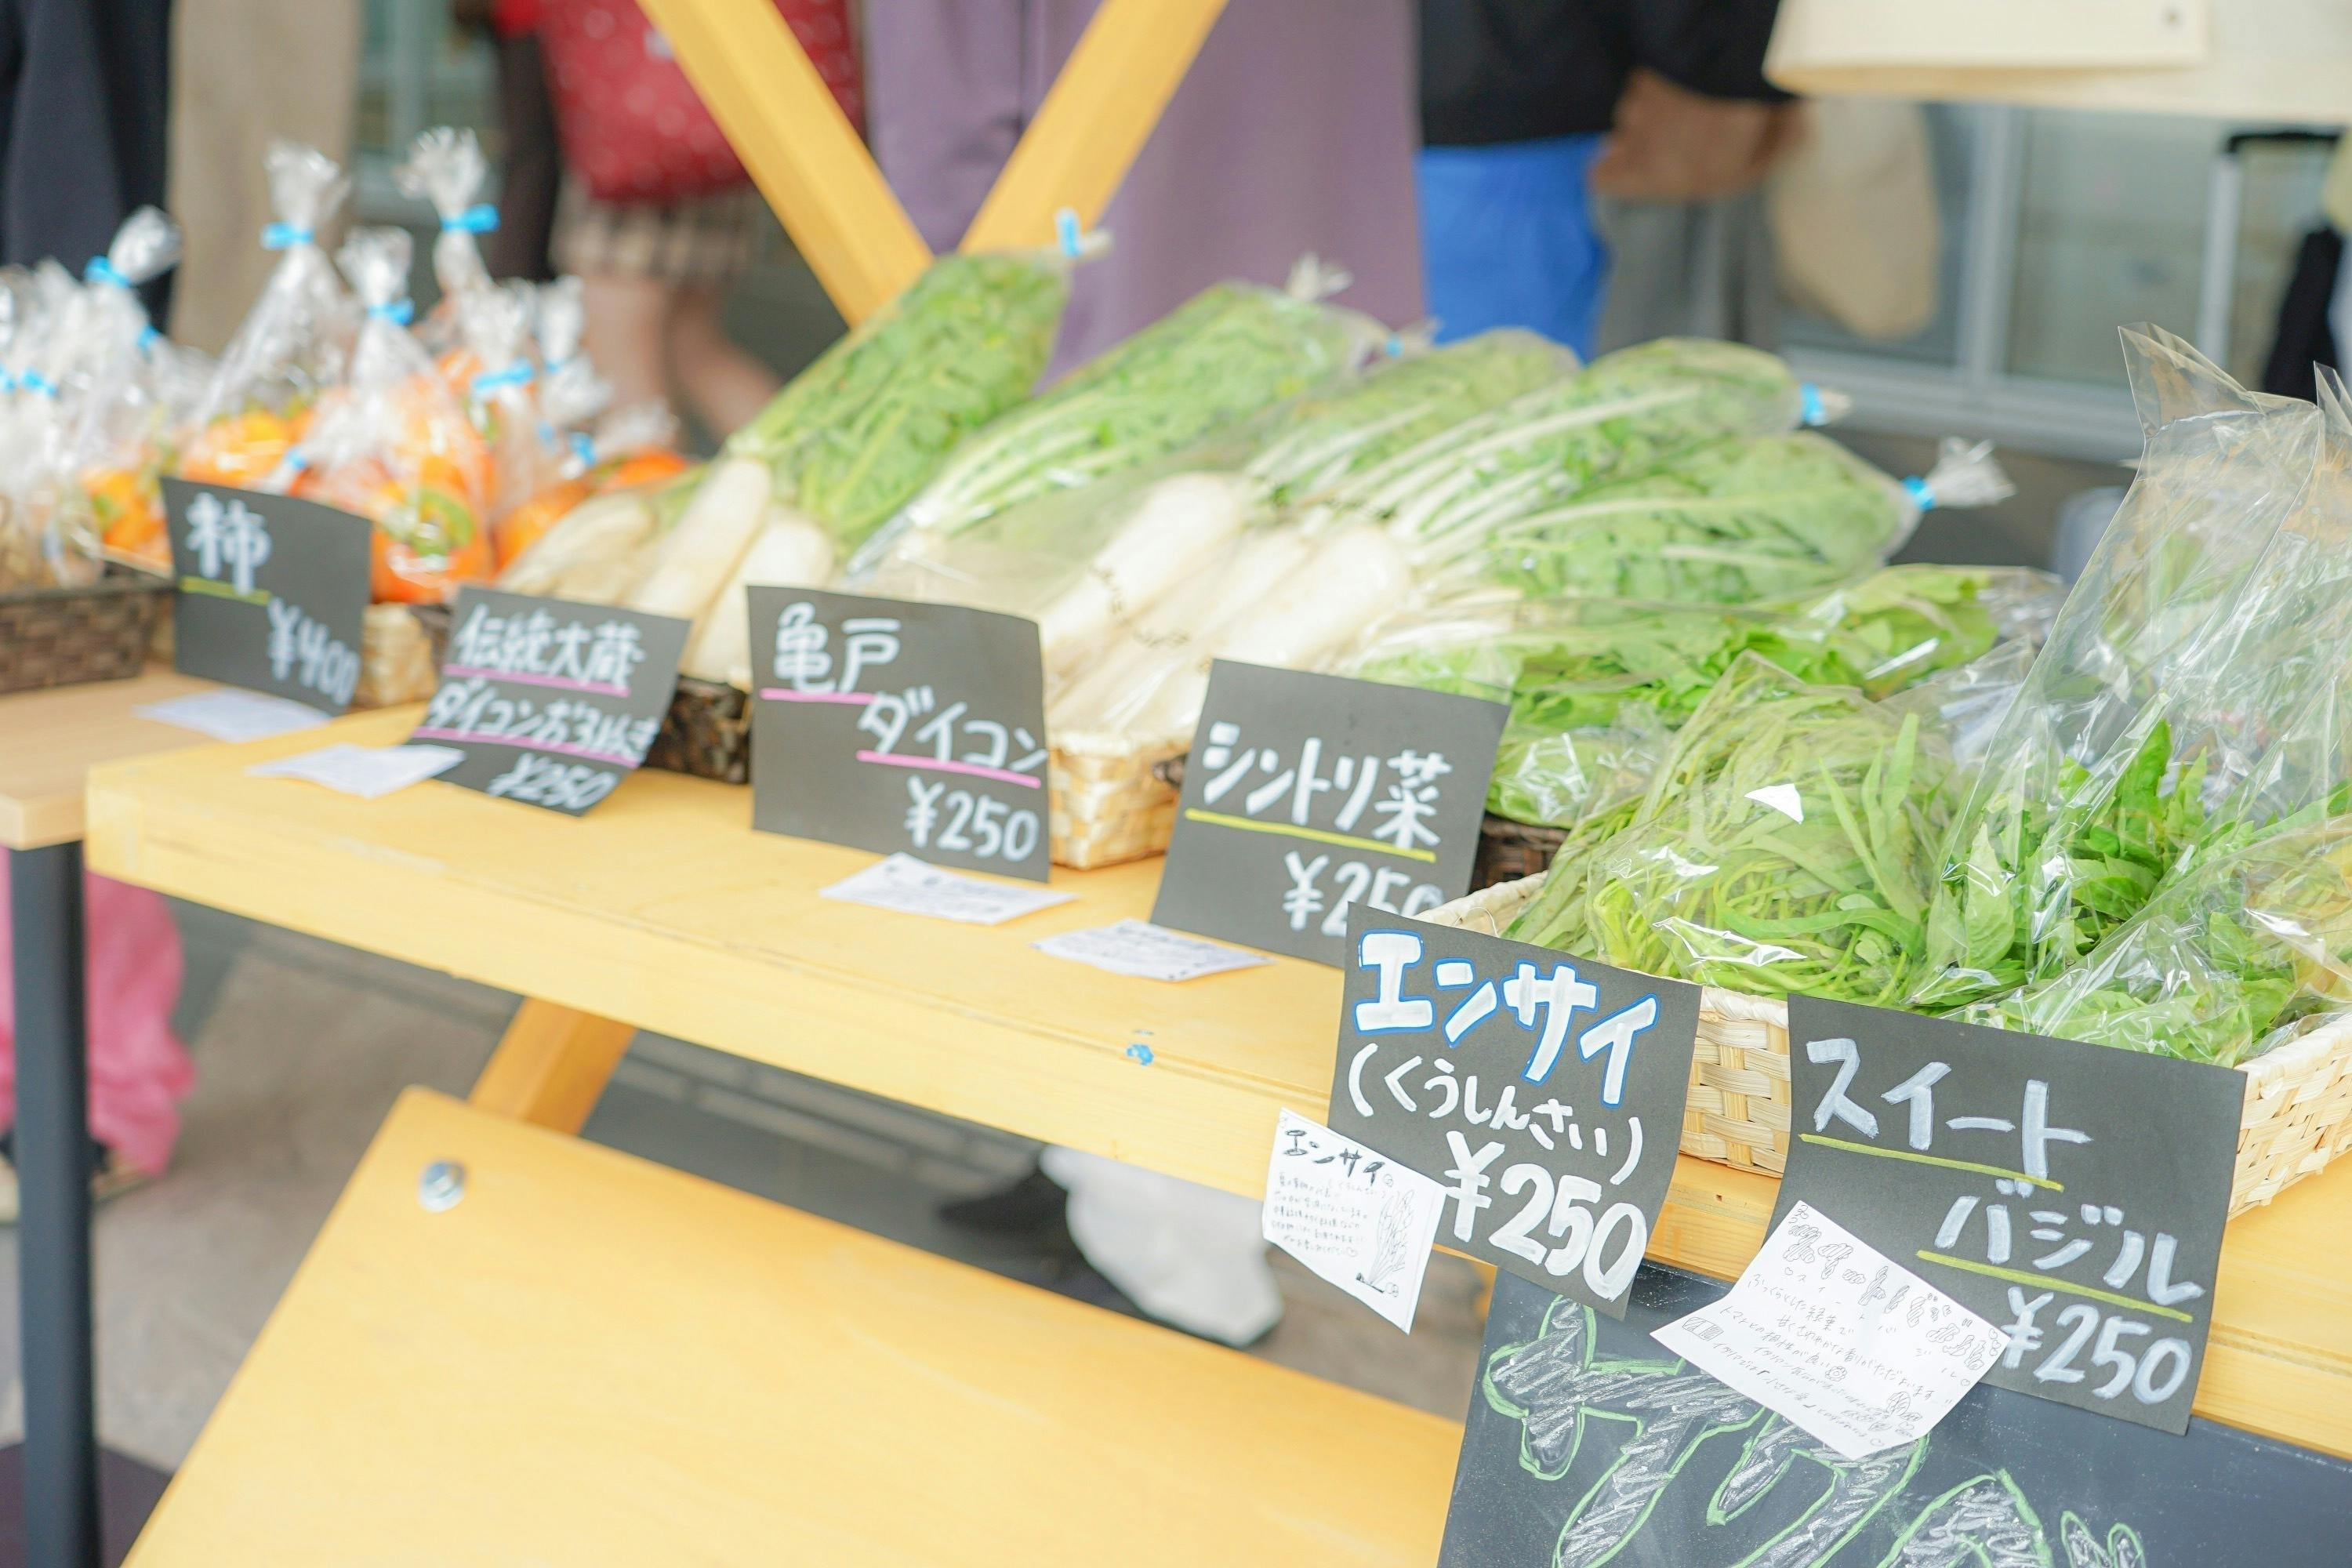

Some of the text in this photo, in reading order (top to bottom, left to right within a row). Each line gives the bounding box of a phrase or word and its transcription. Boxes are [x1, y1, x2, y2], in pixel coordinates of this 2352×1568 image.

[267, 597, 361, 706] ¥400
[774, 601, 902, 694] 亀戸
[485, 752, 619, 811] ¥250
[856, 685, 1048, 771] ダイコン
[904, 774, 1040, 862] ¥250
[1202, 720, 1453, 850] シントリ菜
[1354, 928, 1661, 1108] エンサイ
[1283, 1129, 1385, 1186] エンサイ
[1806, 1036, 2093, 1181] スイート
[1443, 1130, 1648, 1302] ¥250
[1933, 1177, 2205, 1306] バジル
[1999, 1286, 2191, 1404] ¥250
